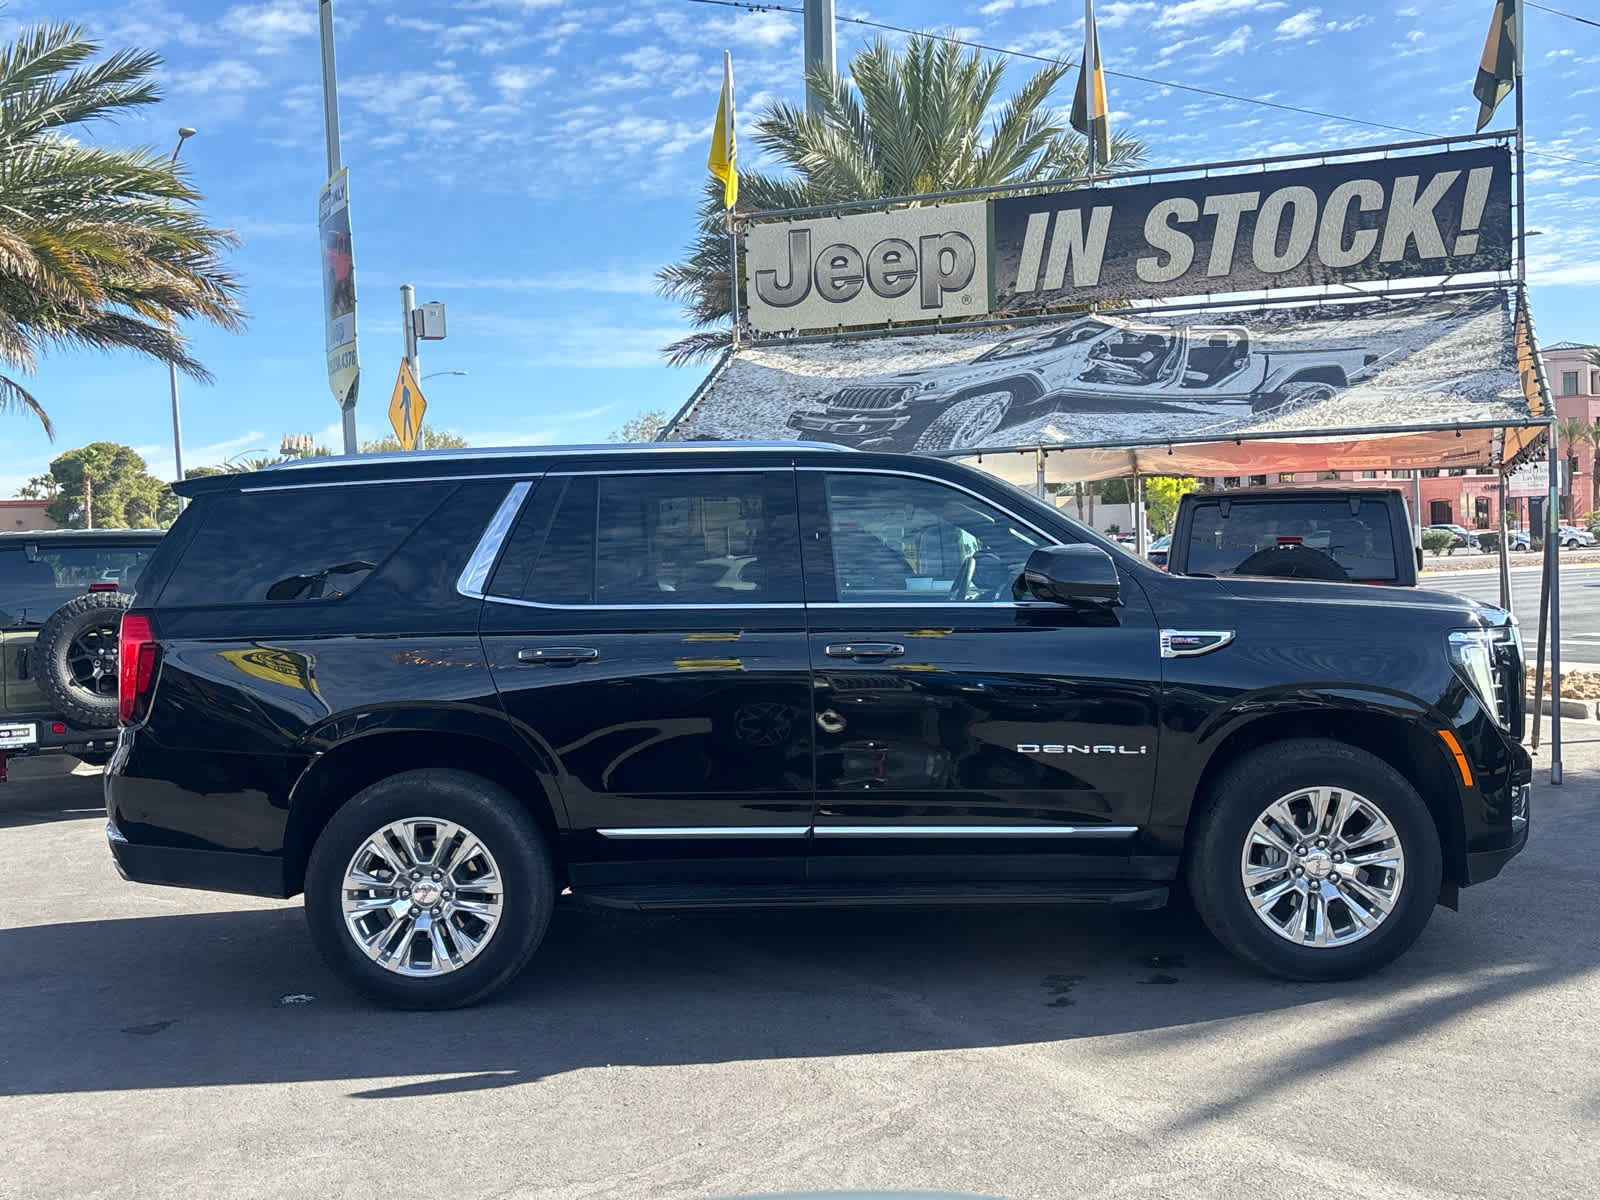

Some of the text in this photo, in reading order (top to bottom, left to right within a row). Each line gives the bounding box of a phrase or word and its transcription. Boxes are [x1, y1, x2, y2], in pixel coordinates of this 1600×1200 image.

[755, 165, 1494, 310] Jeep IN STOCK!
[1017, 743, 1147, 755] DENALI
